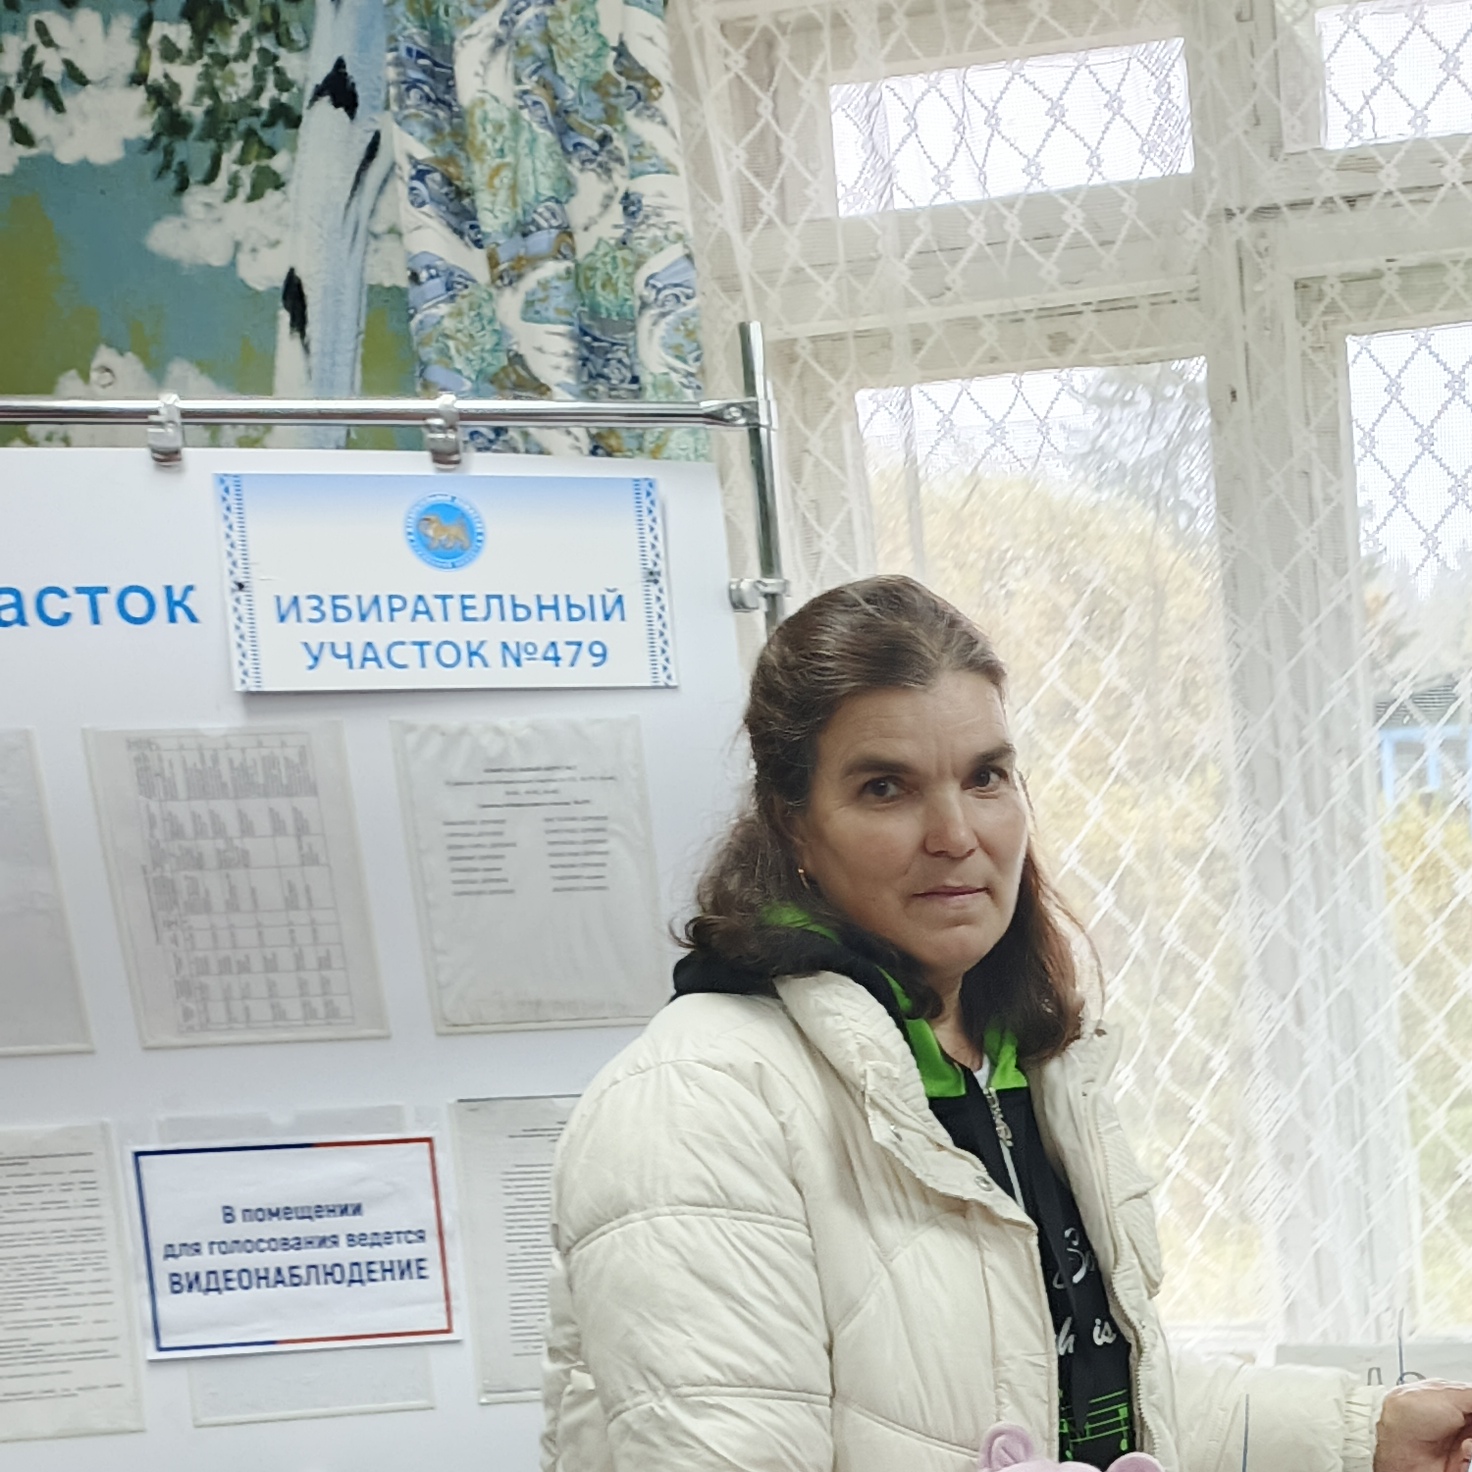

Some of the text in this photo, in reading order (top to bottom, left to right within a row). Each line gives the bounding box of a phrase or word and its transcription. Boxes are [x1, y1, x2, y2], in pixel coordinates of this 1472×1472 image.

[274, 588, 627, 624] ИЗБИРАТЕЛЬНЫЙ
[299, 640, 609, 670] УЧАСТОК №479
[222, 1202, 364, 1224] В помещении
[163, 1228, 427, 1261] для голосования ведется
[168, 1257, 431, 1295] ВИДЕОНАБЛЮДЕНИЕ
